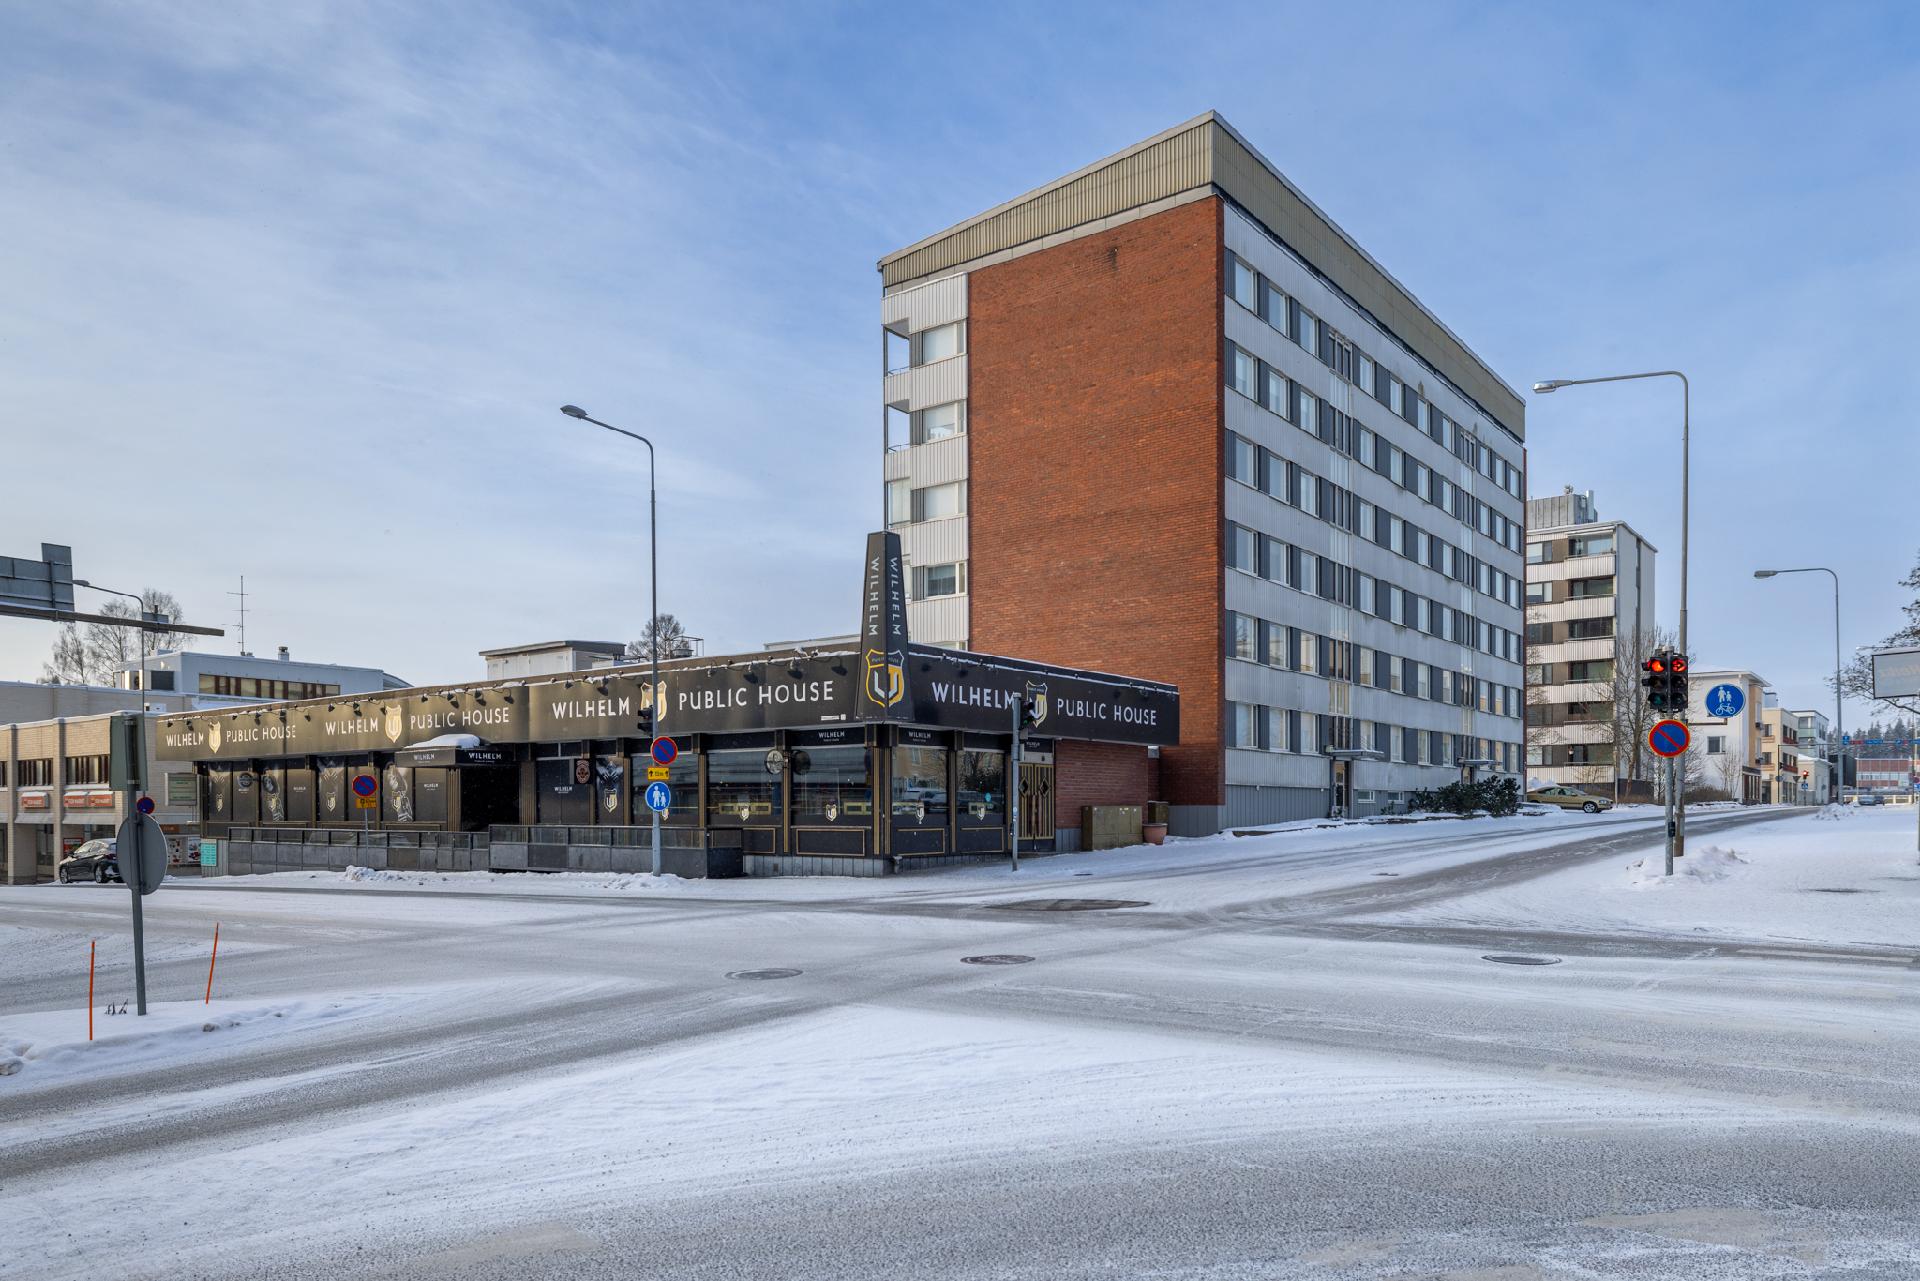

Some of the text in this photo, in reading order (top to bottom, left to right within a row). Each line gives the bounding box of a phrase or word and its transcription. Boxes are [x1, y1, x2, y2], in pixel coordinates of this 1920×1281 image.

[868, 556, 880, 636] WILHELM
[888, 557, 902, 636] WILHELM
[552, 680, 834, 720] WILHELM PUBLIC HOUSE
[932, 682, 1157, 726] WILHELM PUBLIC HOUSE
[166, 724, 296, 747] WILHELM PUBLIC HOUSE
[325, 706, 510, 736] WILHELM PUBLIC HOUSE
[818, 730, 845, 739] WILHELM
[468, 752, 502, 760] WILHELM
